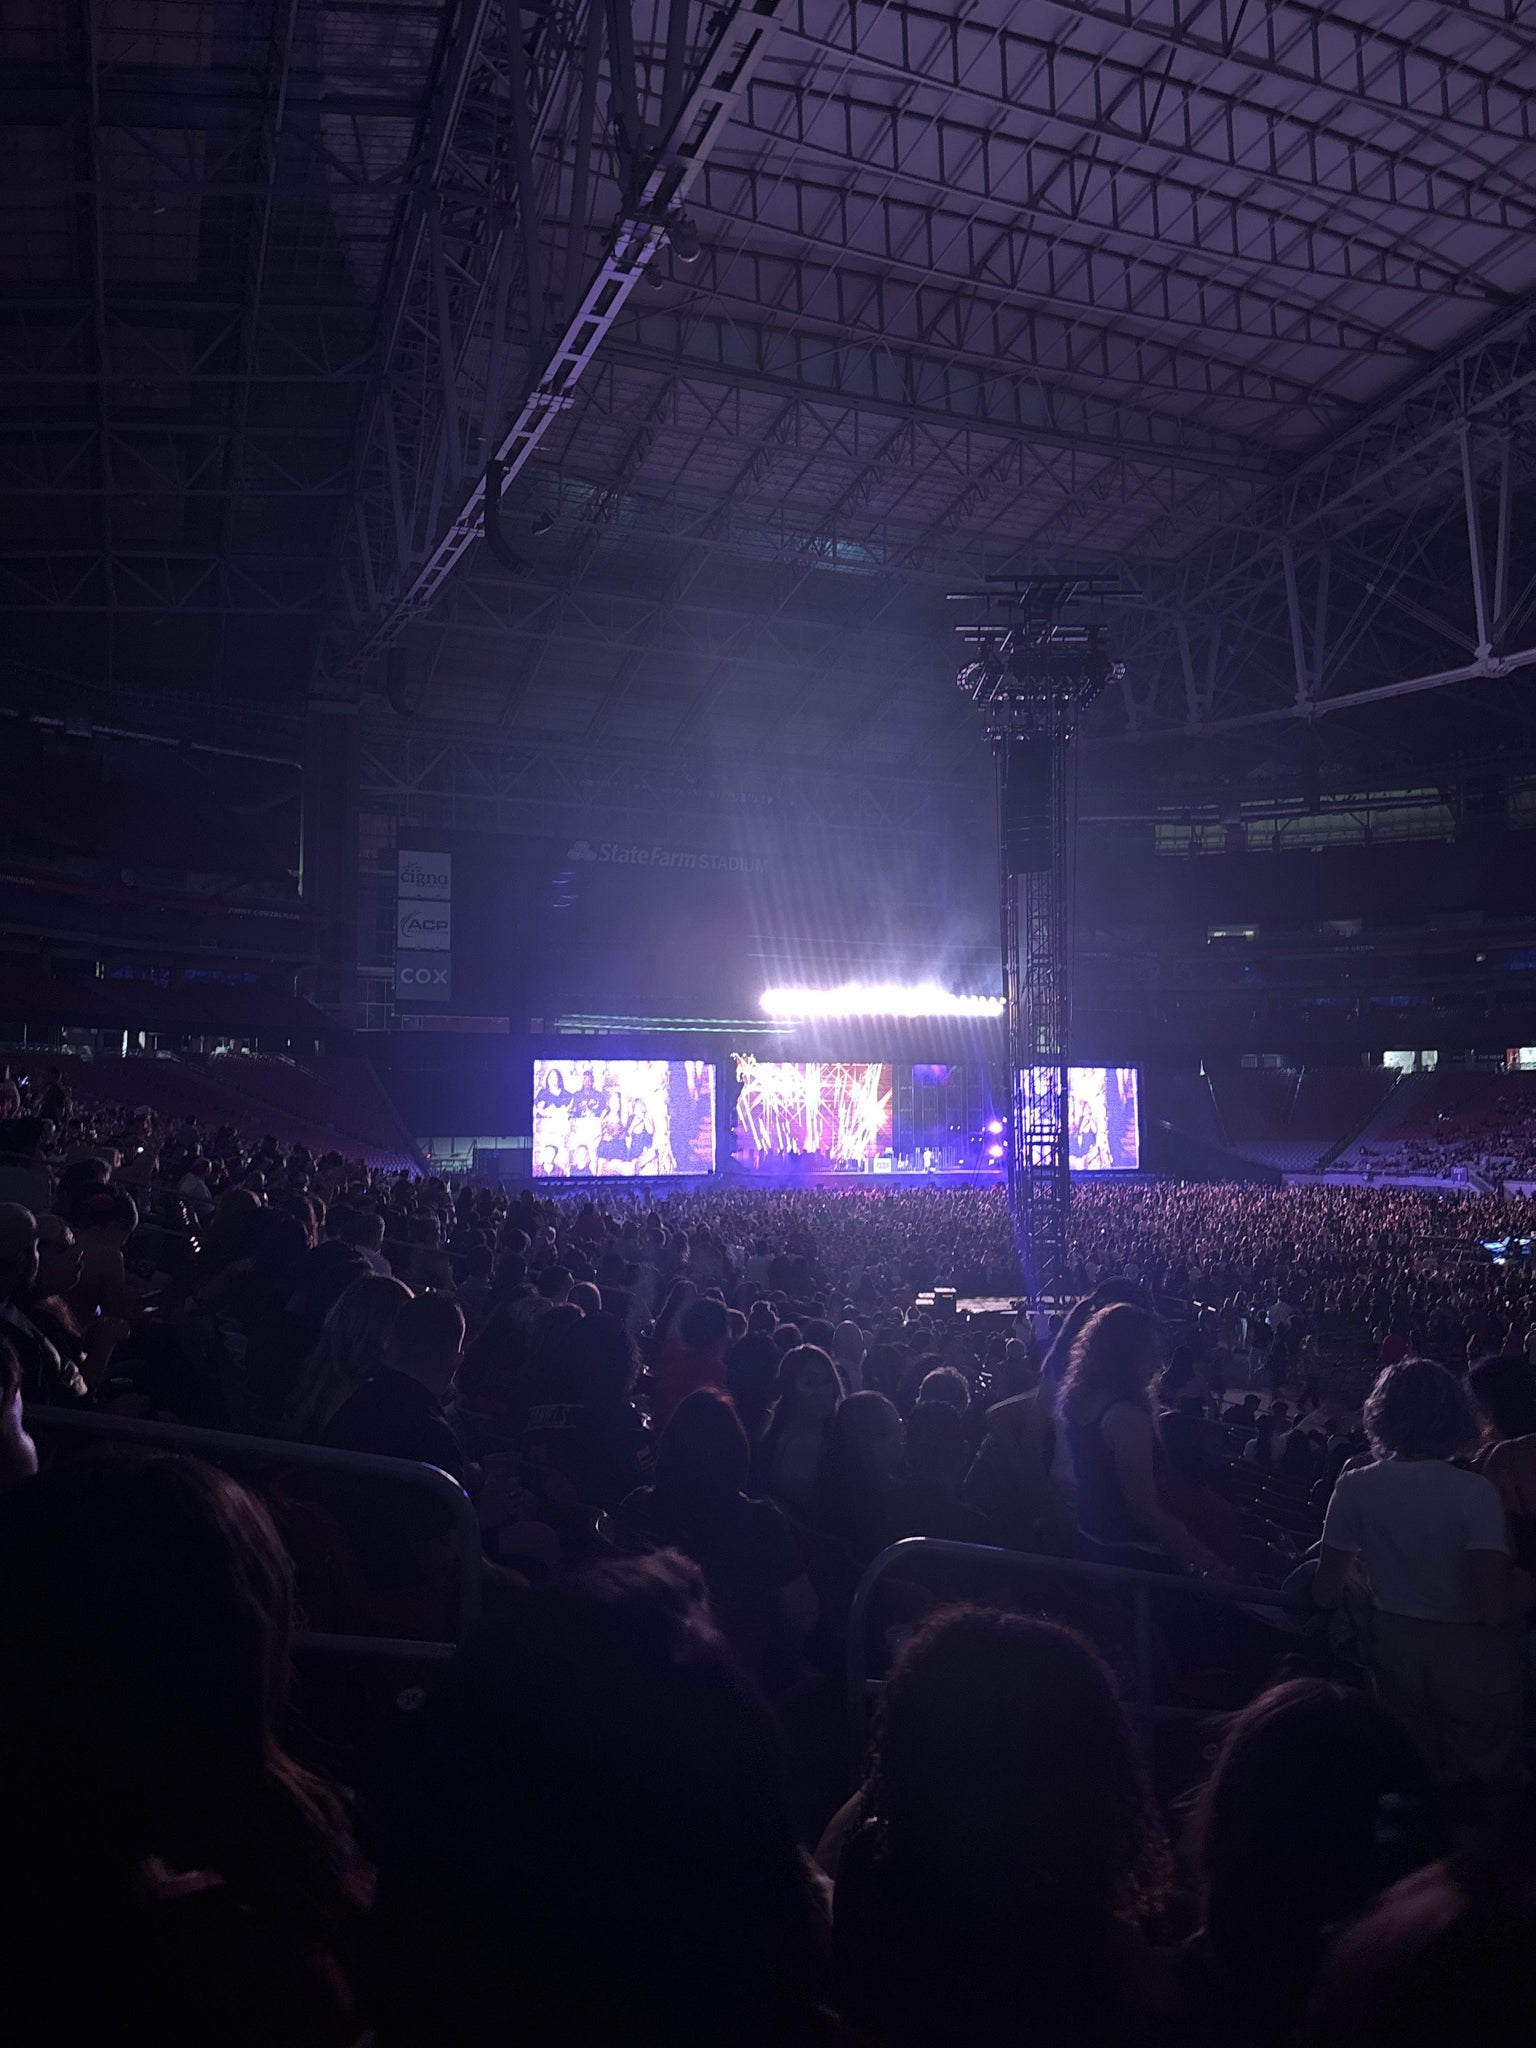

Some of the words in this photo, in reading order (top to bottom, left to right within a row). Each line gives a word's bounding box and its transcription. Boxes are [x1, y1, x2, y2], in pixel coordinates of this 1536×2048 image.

[699, 854, 769, 873] STADIUM
[400, 868, 448, 888] cigna
[408, 919, 449, 931] ACP
[400, 967, 448, 985] COX
